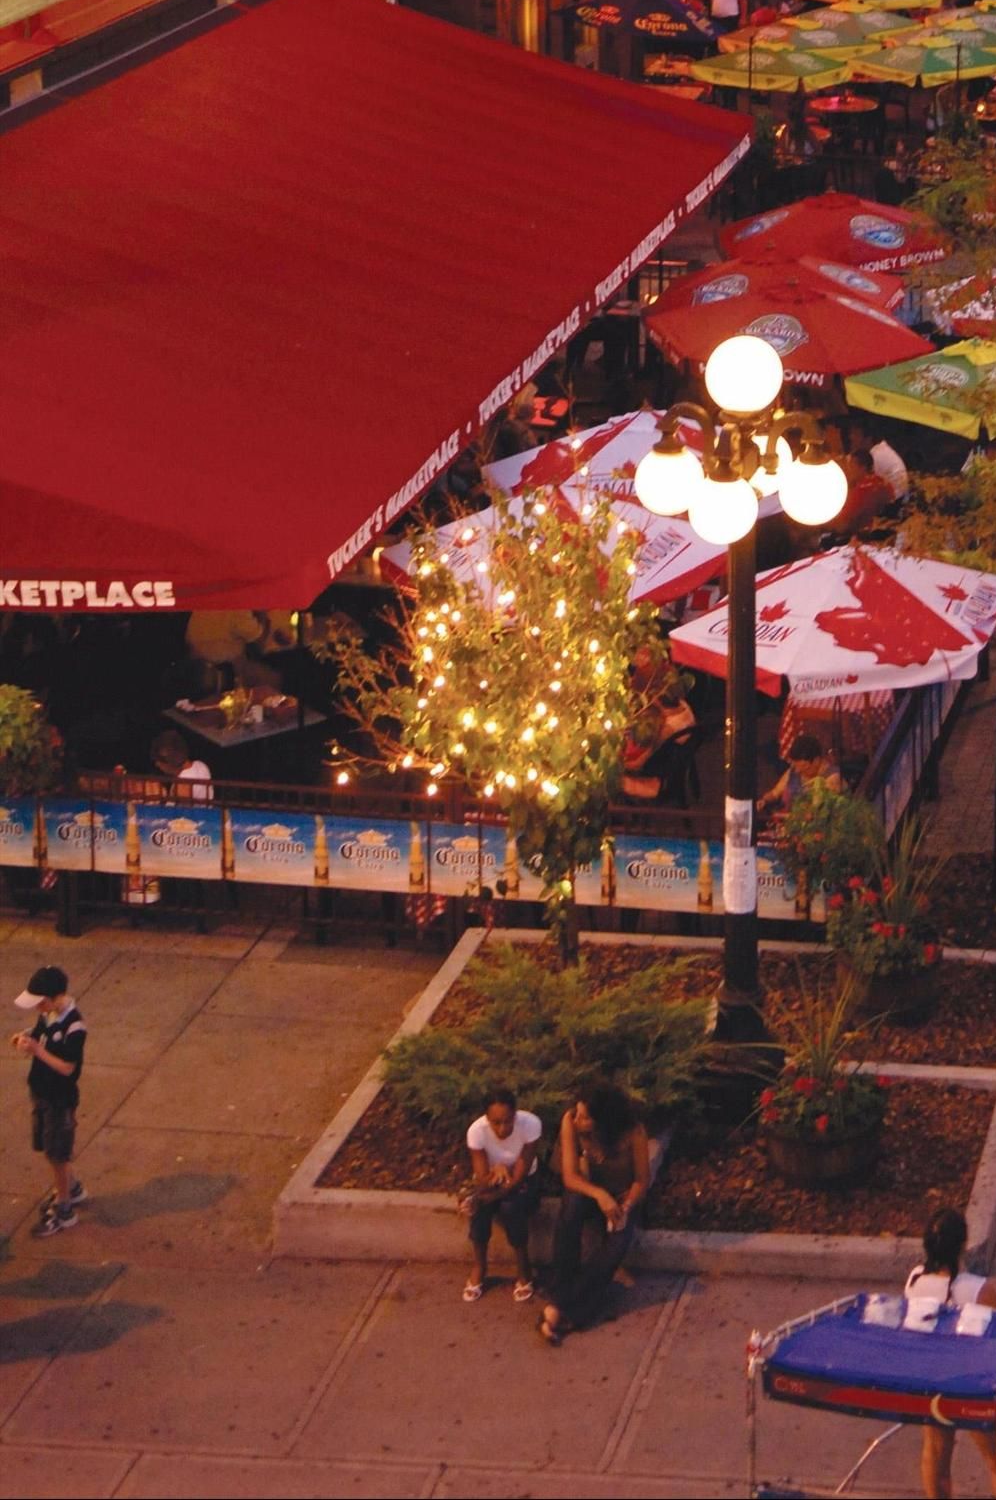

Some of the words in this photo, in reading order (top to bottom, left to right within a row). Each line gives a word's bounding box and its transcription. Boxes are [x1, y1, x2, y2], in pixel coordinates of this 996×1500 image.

[900, 248, 945, 267] BROWN
[479, 365, 521, 426] TUCKER'S
[522, 305, 580, 384] MARKETPLACE
[327, 503, 385, 580] TUCKER'S
[385, 428, 461, 524] MARKETPLACE
[708, 617, 798, 643] CADIAN
[793, 668, 844, 694] CANADIAN
[57, 822, 117, 843] Corona
[151, 829, 211, 848] Corona
[245, 835, 305, 854] Corona
[339, 841, 400, 861] Corona
[627, 860, 690, 881] Corona
